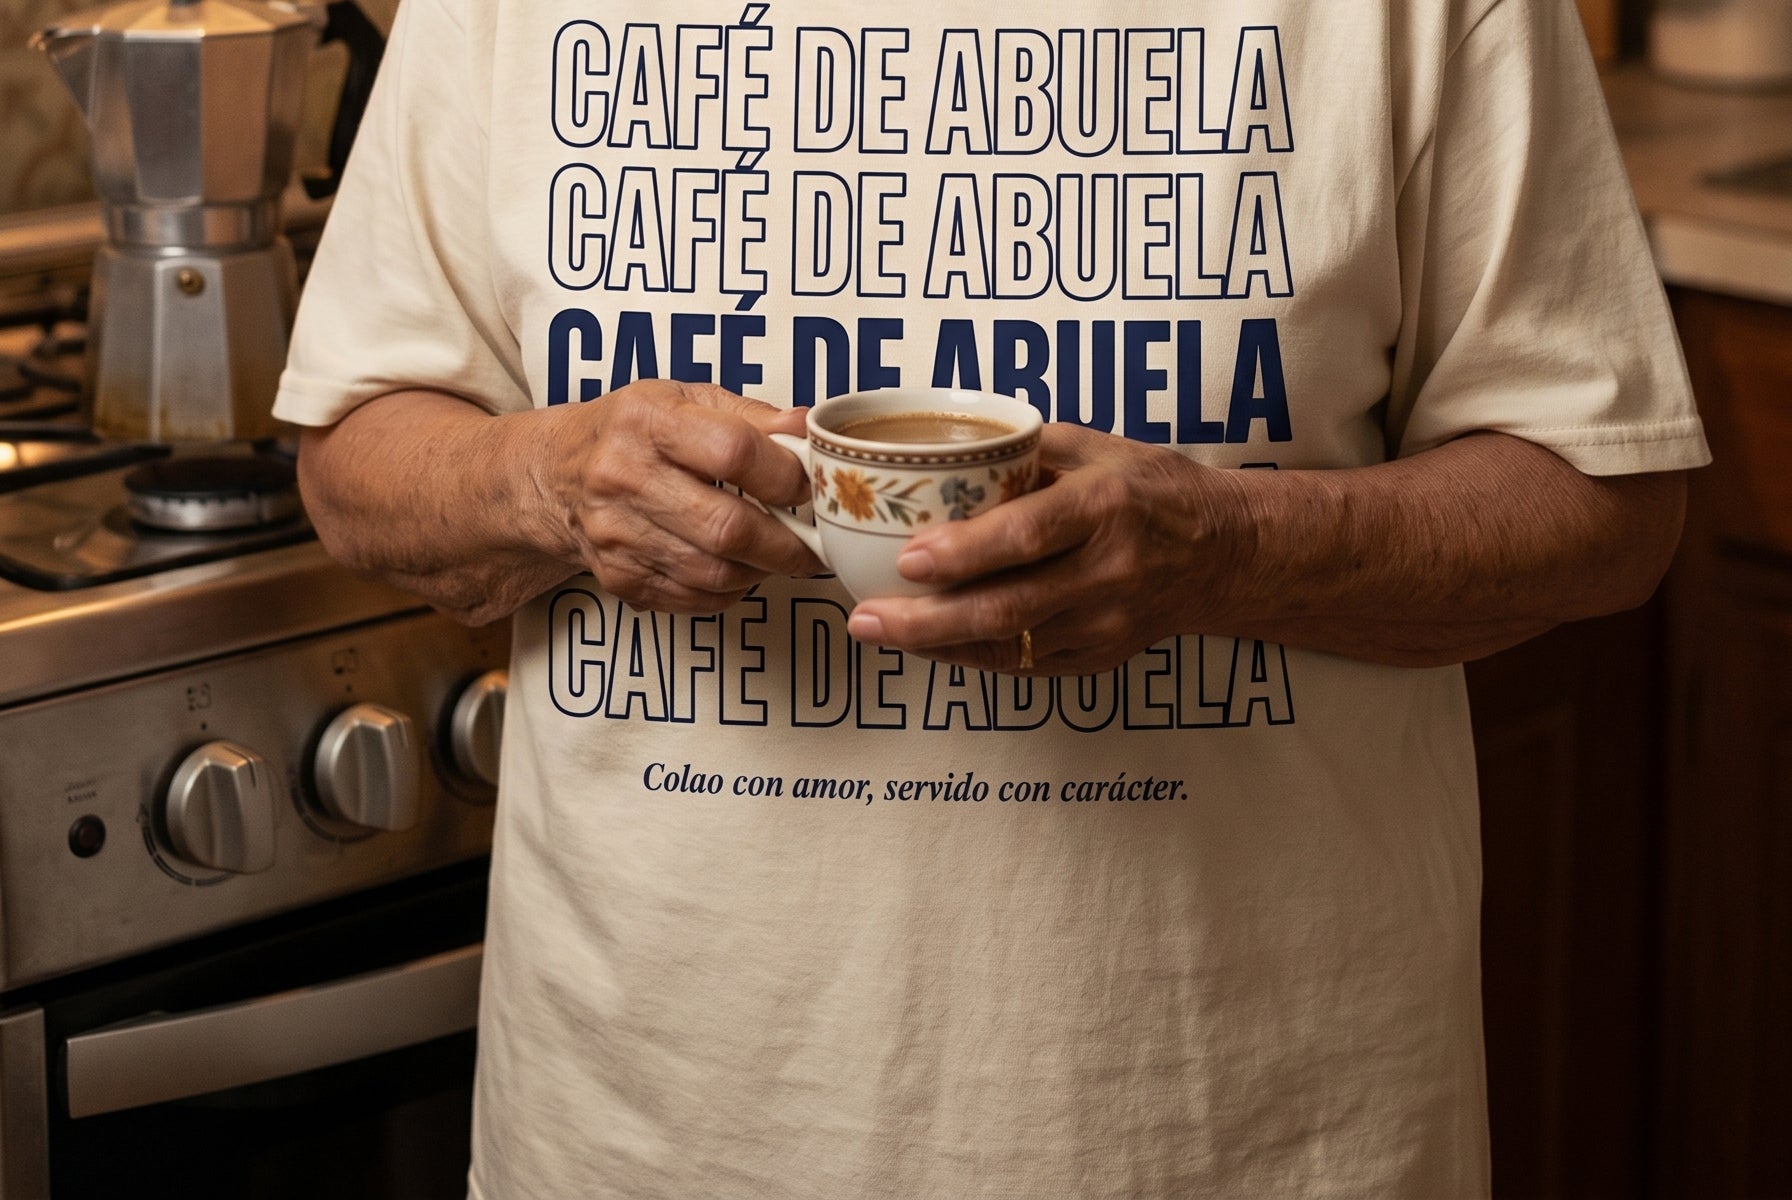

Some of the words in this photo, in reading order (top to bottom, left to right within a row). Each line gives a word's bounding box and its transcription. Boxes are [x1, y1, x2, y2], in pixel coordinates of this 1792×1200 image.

[550, 3, 773, 151] CAFÉ
[793, 26, 909, 154] DE
[925, 25, 1294, 156] ABUELA
[547, 149, 769, 295] CAFÉ
[791, 171, 906, 298] DE
[923, 171, 1294, 302] ABUELA
[931, 318, 1293, 444] ABUELA
[548, 584, 768, 727] CAFÉ
[791, 597, 906, 730] DE
[643, 762, 724, 795] Colao
[732, 774, 784, 798] con
[792, 777, 874, 806] amor,
[883, 771, 990, 802] servido
[998, 779, 1050, 803] con
[1060, 771, 1188, 802] carácter.
